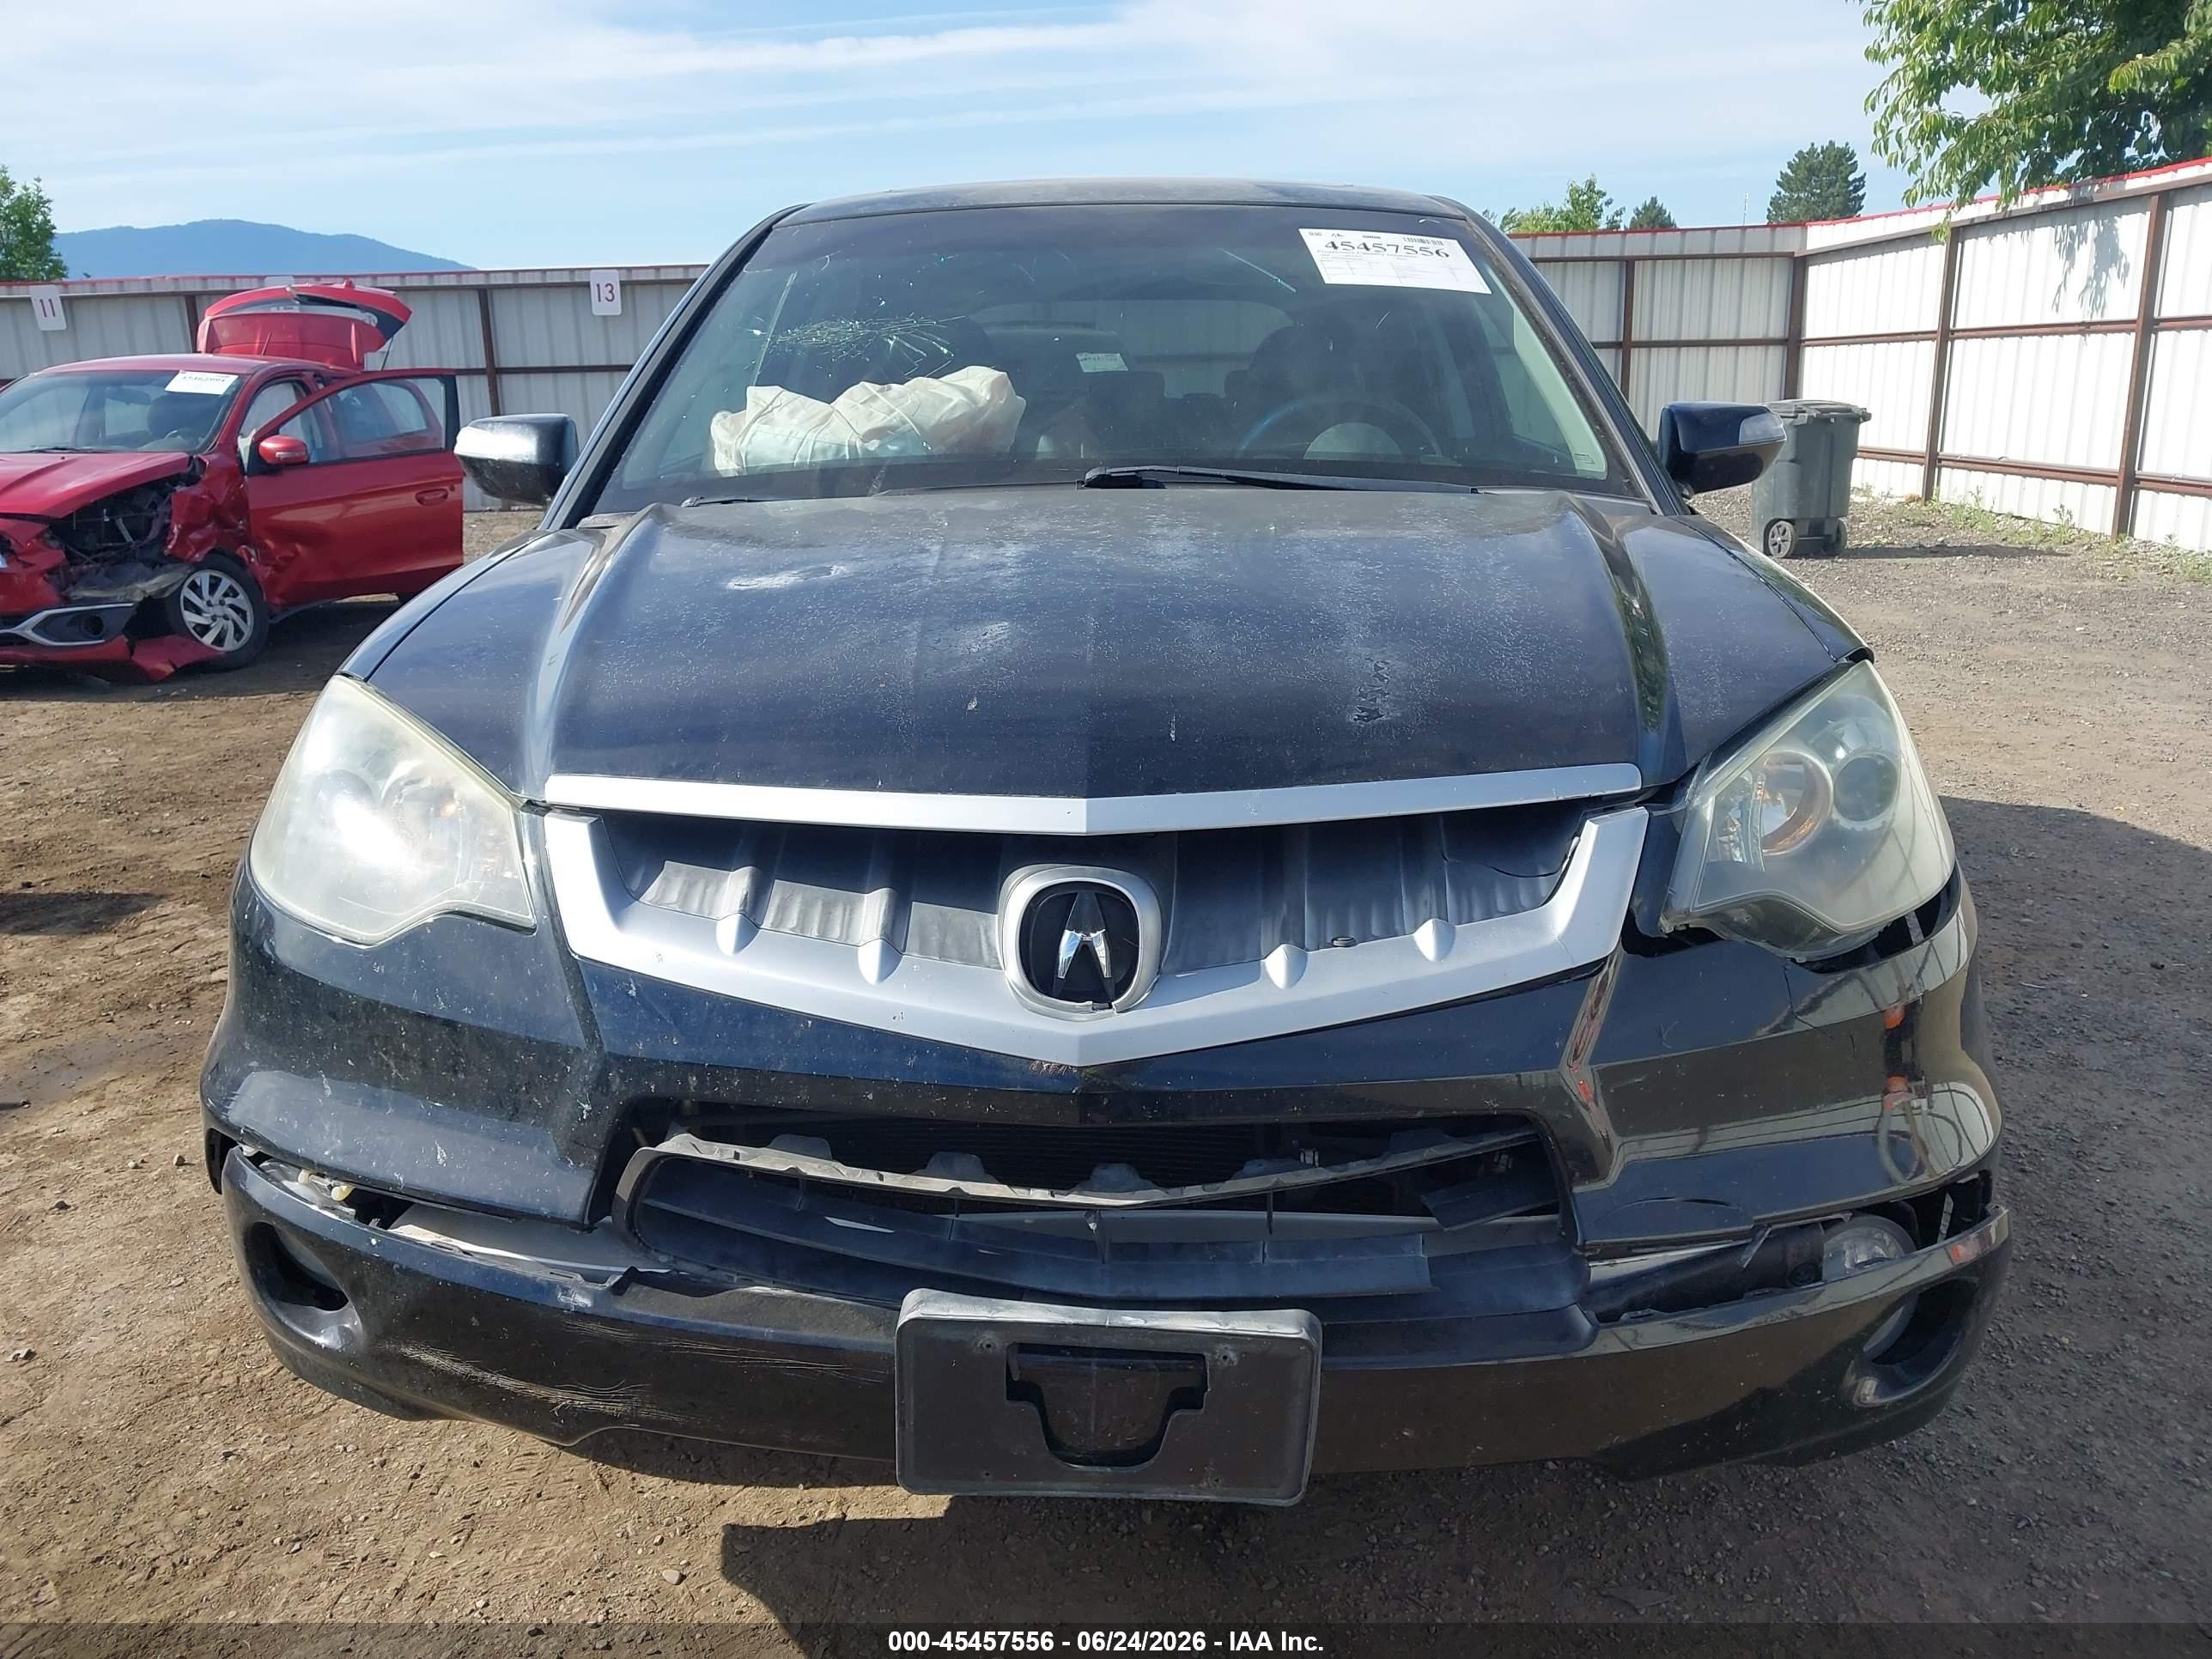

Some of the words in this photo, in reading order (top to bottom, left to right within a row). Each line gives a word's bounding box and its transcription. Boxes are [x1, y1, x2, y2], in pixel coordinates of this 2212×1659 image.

[1325, 240, 1449, 258] 45457556
[596, 283, 615, 302] 13
[40, 298, 56, 317] 11
